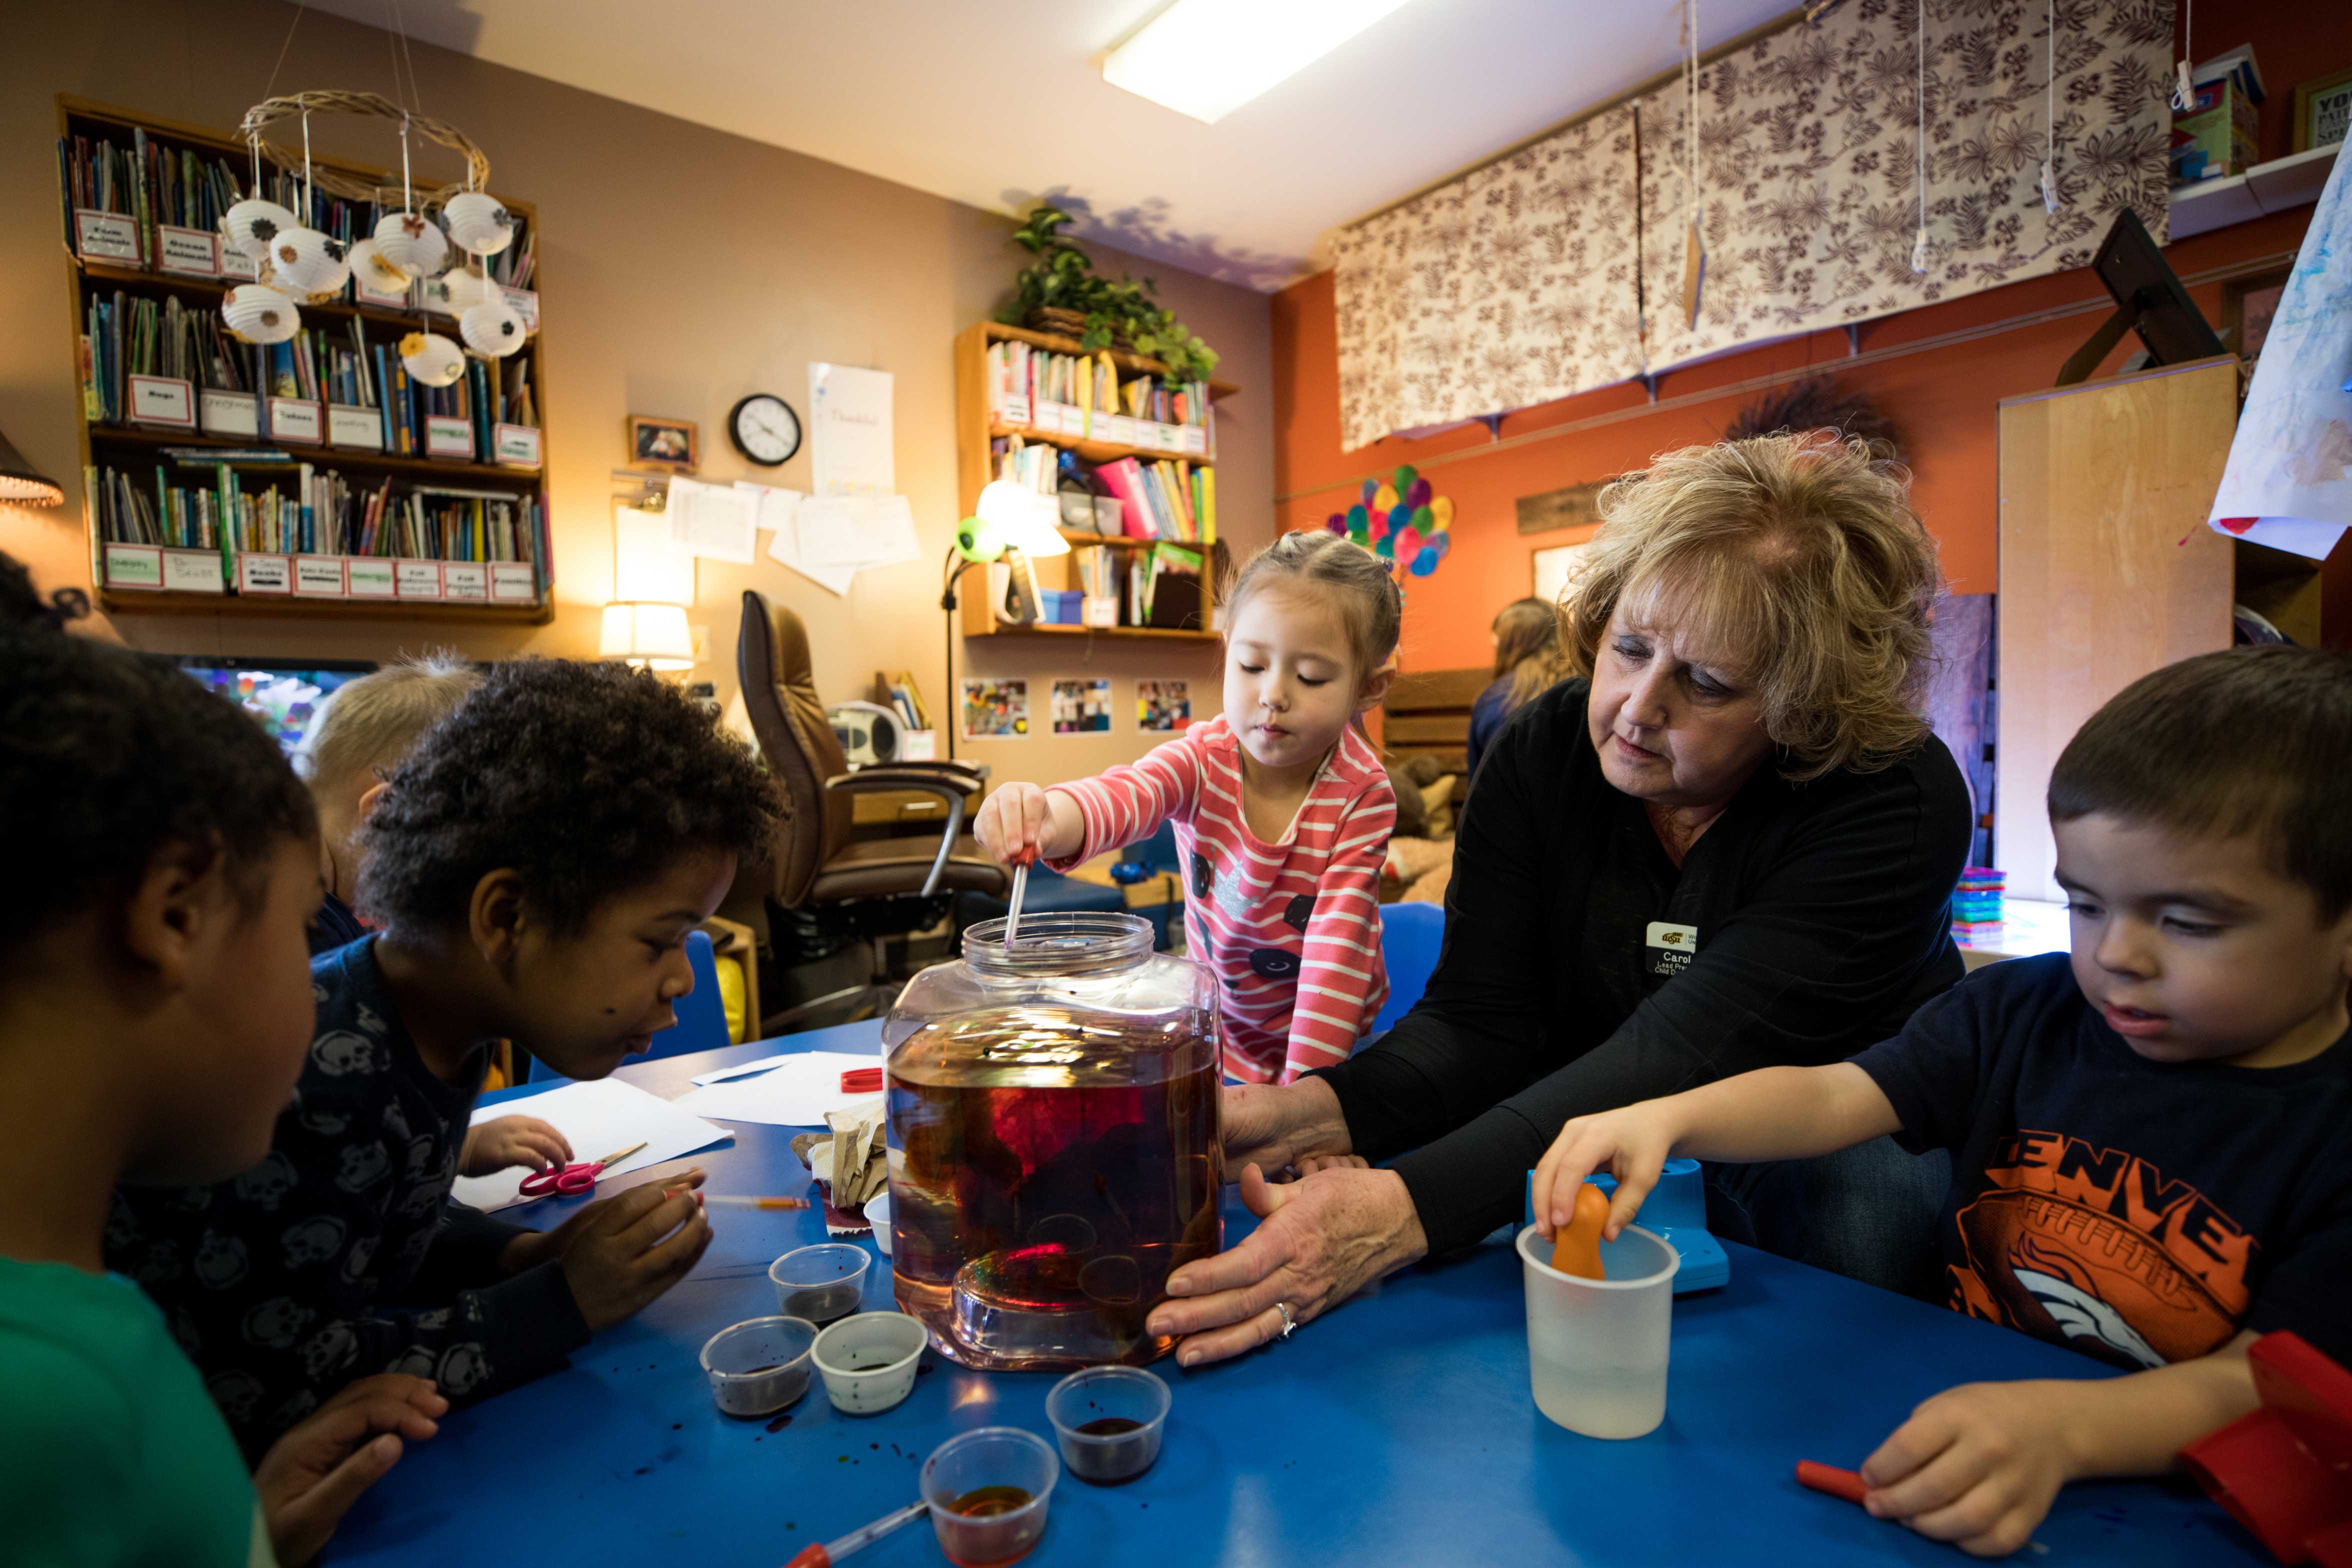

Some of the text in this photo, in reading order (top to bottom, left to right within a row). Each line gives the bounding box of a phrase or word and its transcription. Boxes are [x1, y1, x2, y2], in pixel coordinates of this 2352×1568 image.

[166, 249, 212, 262] Animals
[1658, 960, 1673, 968] Lead
[1664, 952, 1691, 964] Carol
